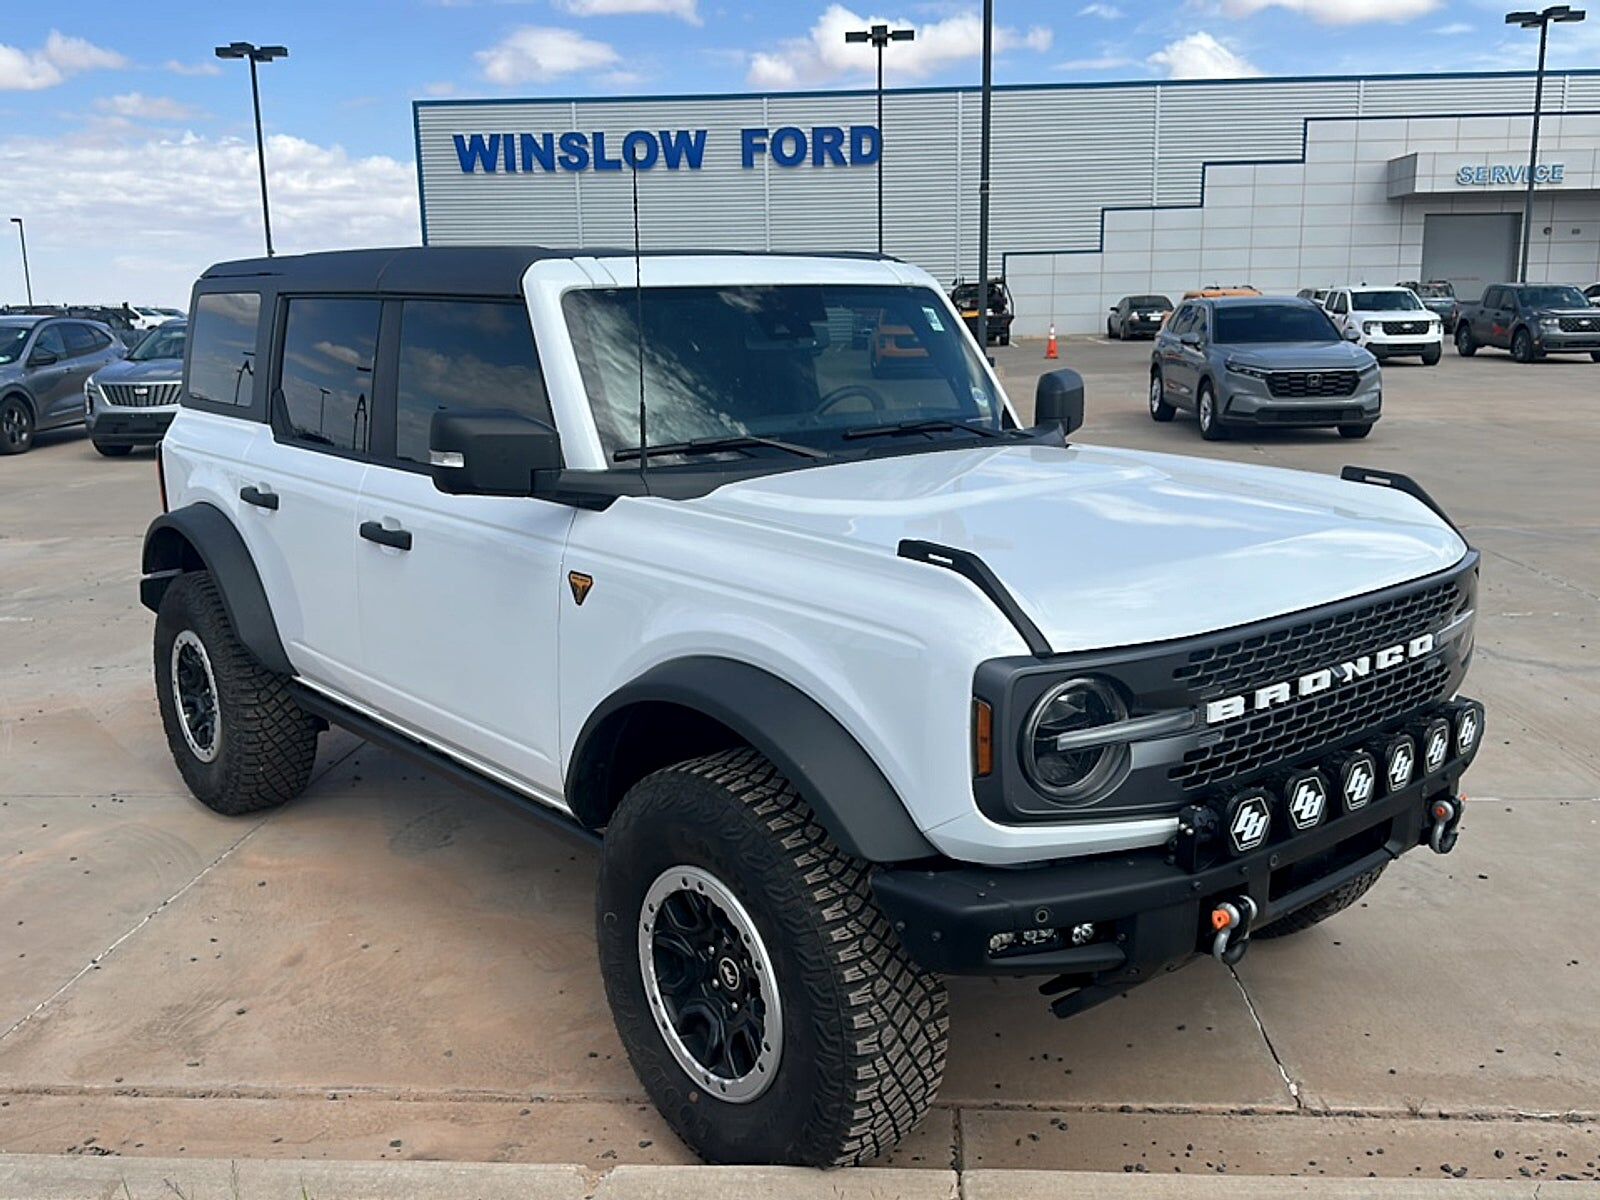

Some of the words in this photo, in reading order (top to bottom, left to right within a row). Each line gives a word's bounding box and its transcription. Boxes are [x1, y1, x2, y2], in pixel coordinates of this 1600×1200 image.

[452, 129, 708, 173] WINSLOW
[741, 125, 882, 169] FORD
[1457, 164, 1566, 185] SERVICE
[1206, 633, 1433, 724] BRONCO
